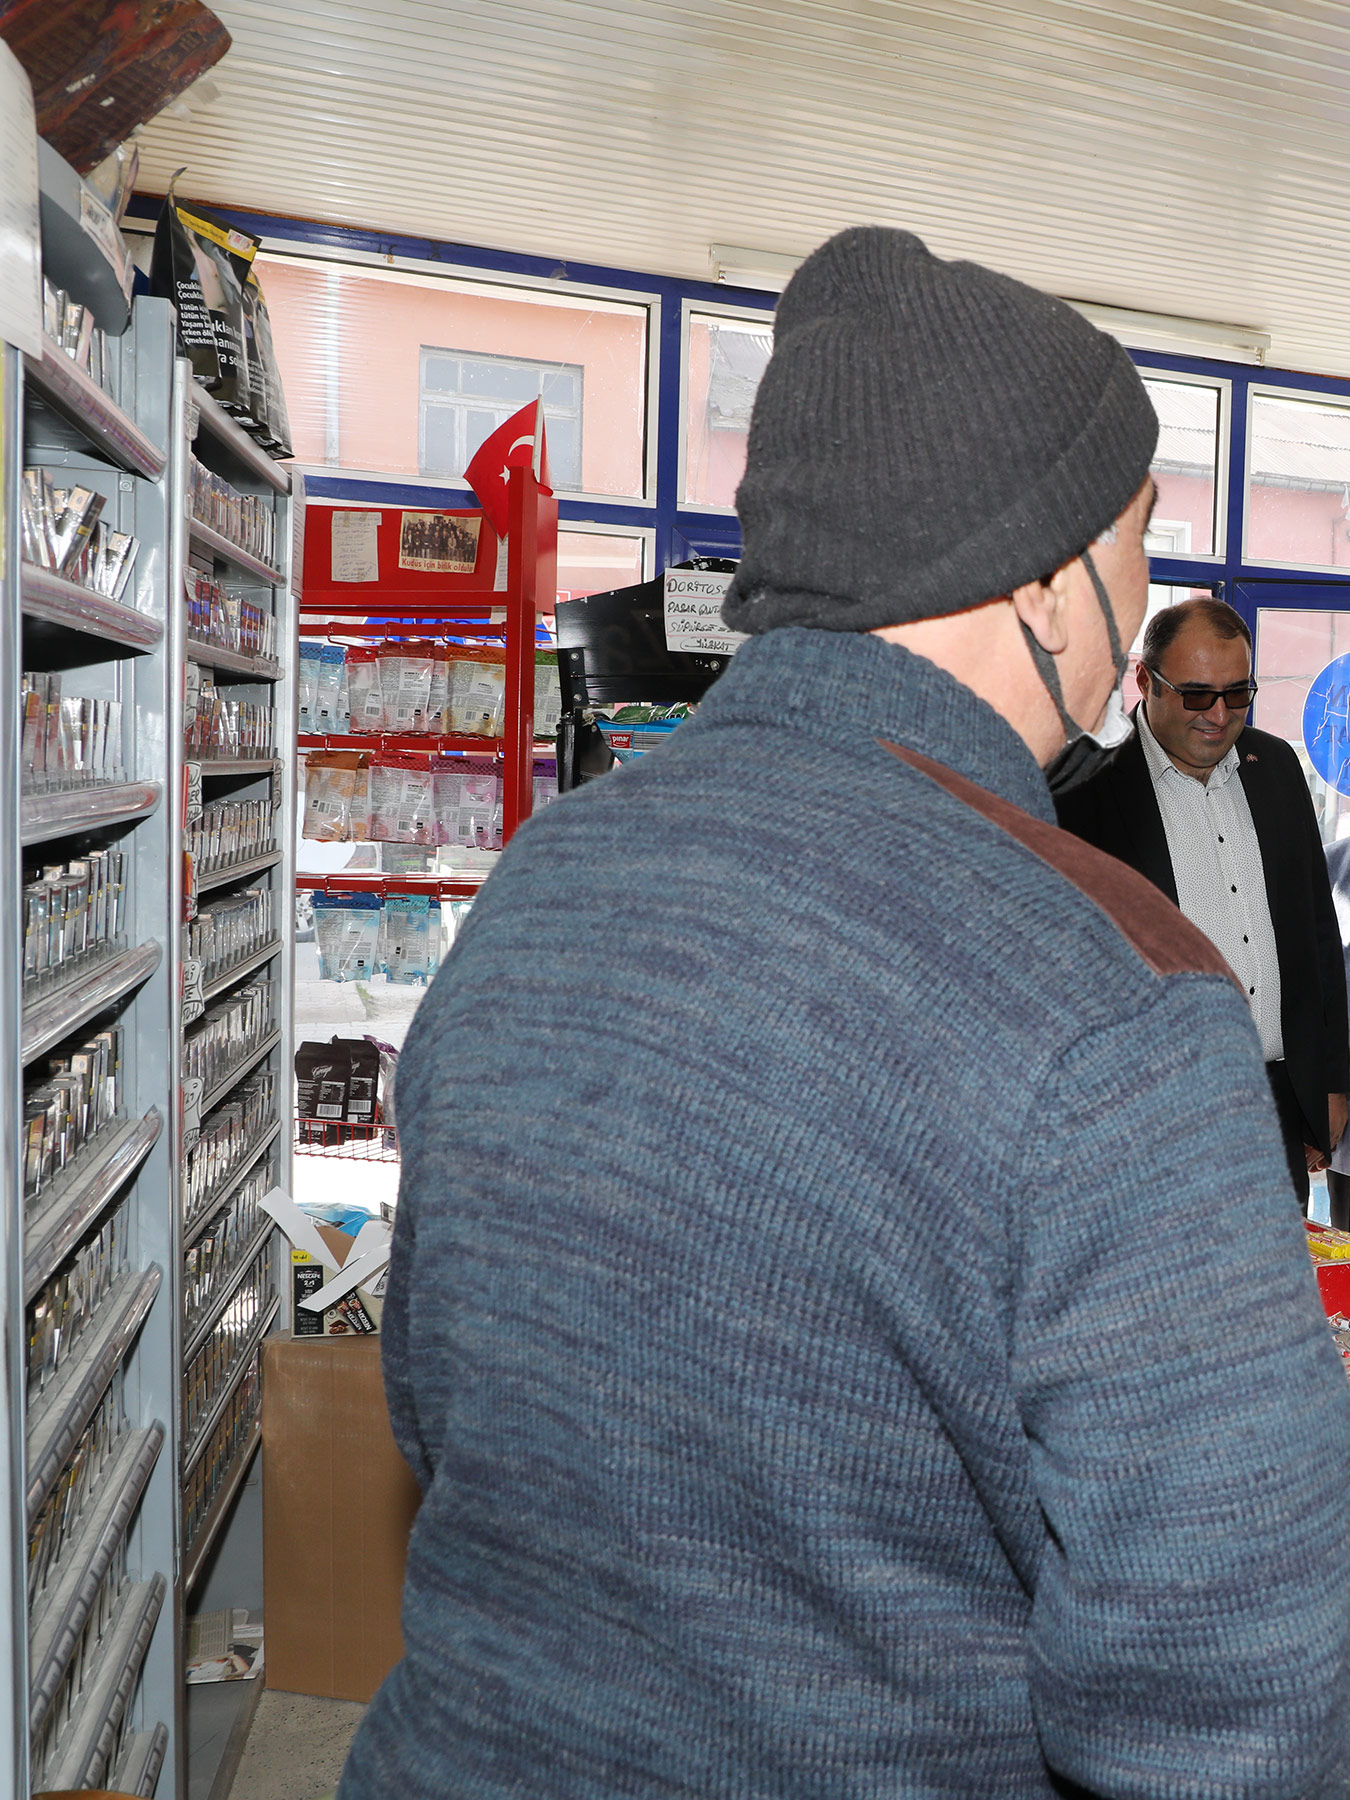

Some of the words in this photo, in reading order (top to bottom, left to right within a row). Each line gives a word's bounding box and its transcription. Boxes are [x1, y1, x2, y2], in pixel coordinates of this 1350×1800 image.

[401, 557, 422, 568] Kudüs
[423, 558, 436, 570] için
[437, 560, 452, 571] birlik
